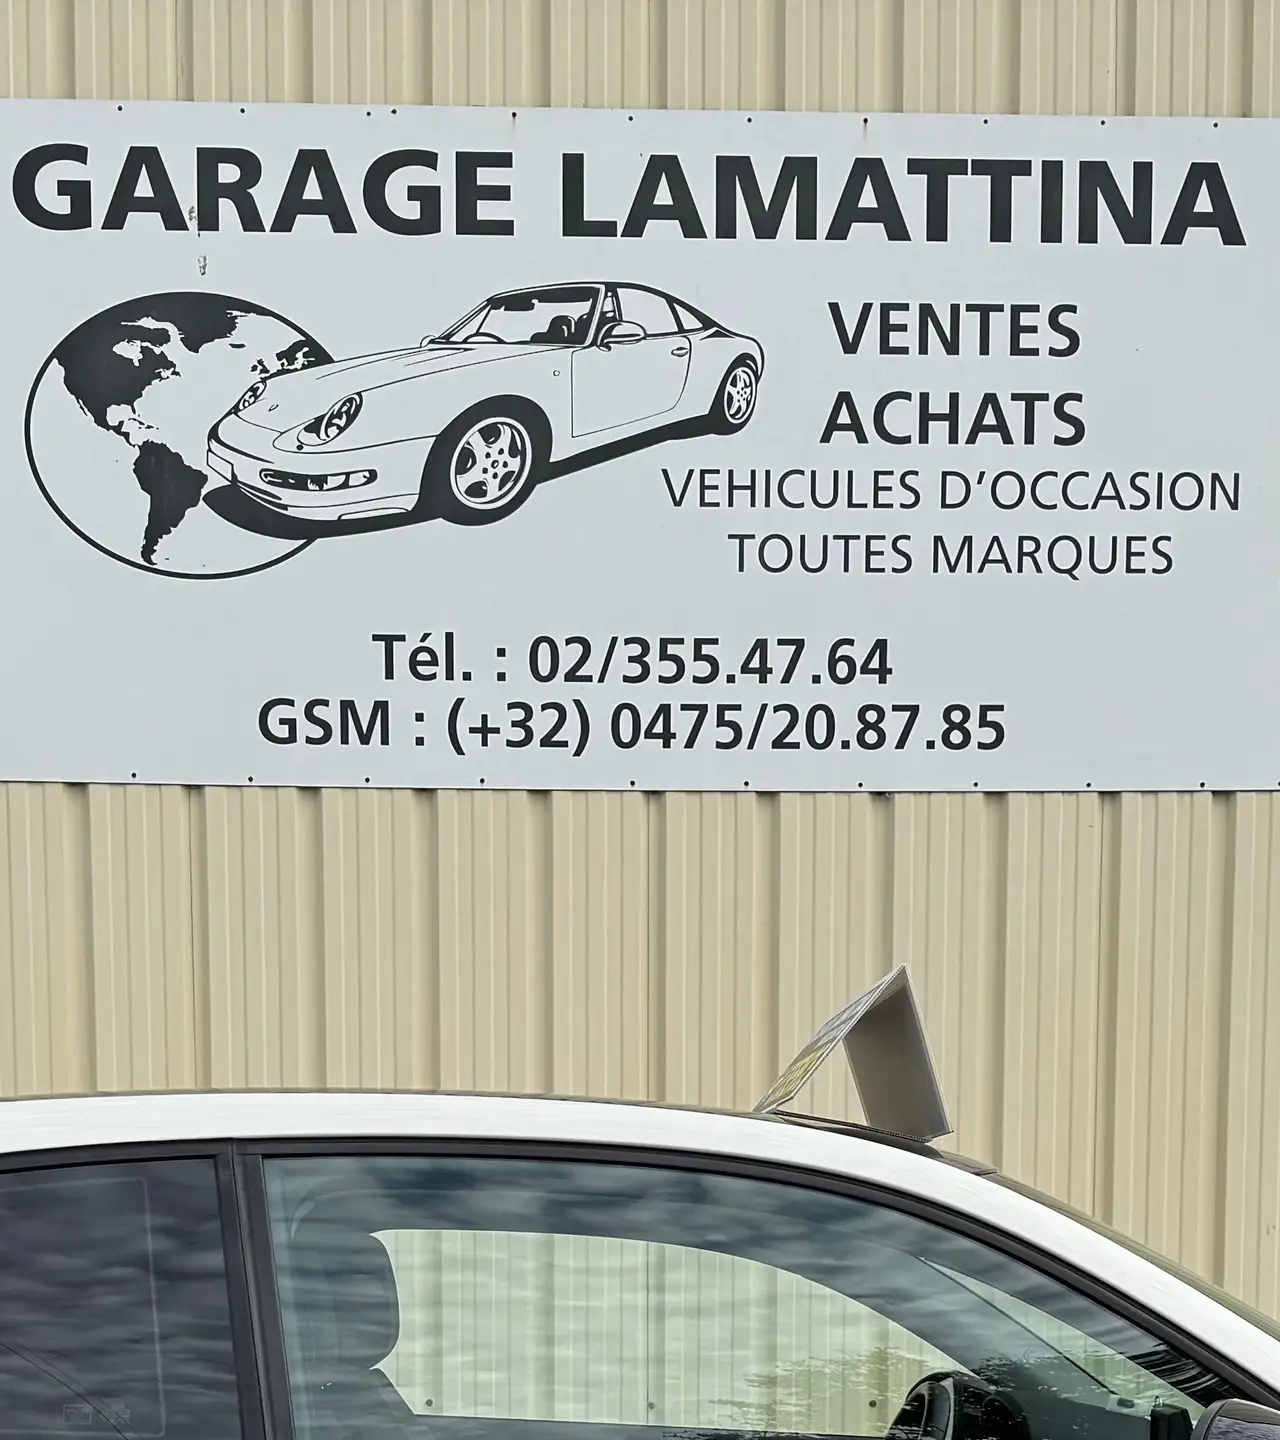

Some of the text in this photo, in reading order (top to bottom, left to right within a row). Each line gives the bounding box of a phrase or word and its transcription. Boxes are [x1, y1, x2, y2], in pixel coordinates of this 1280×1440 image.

[12, 143, 1248, 247] GARAGE LAMATTINA
[827, 301, 1081, 358] VENTES
[819, 390, 1087, 447] ACHATS
[661, 468, 1241, 513] VEHICULES D'OCCASION
[727, 533, 1174, 582] TOUTES MARQUES
[371, 631, 473, 683] Tél.
[528, 635, 894, 685] 02/355.47.64
[258, 697, 391, 747] GSM
[447, 696, 591, 758] (+32)
[610, 702, 1006, 752] 0475/20.87.85
